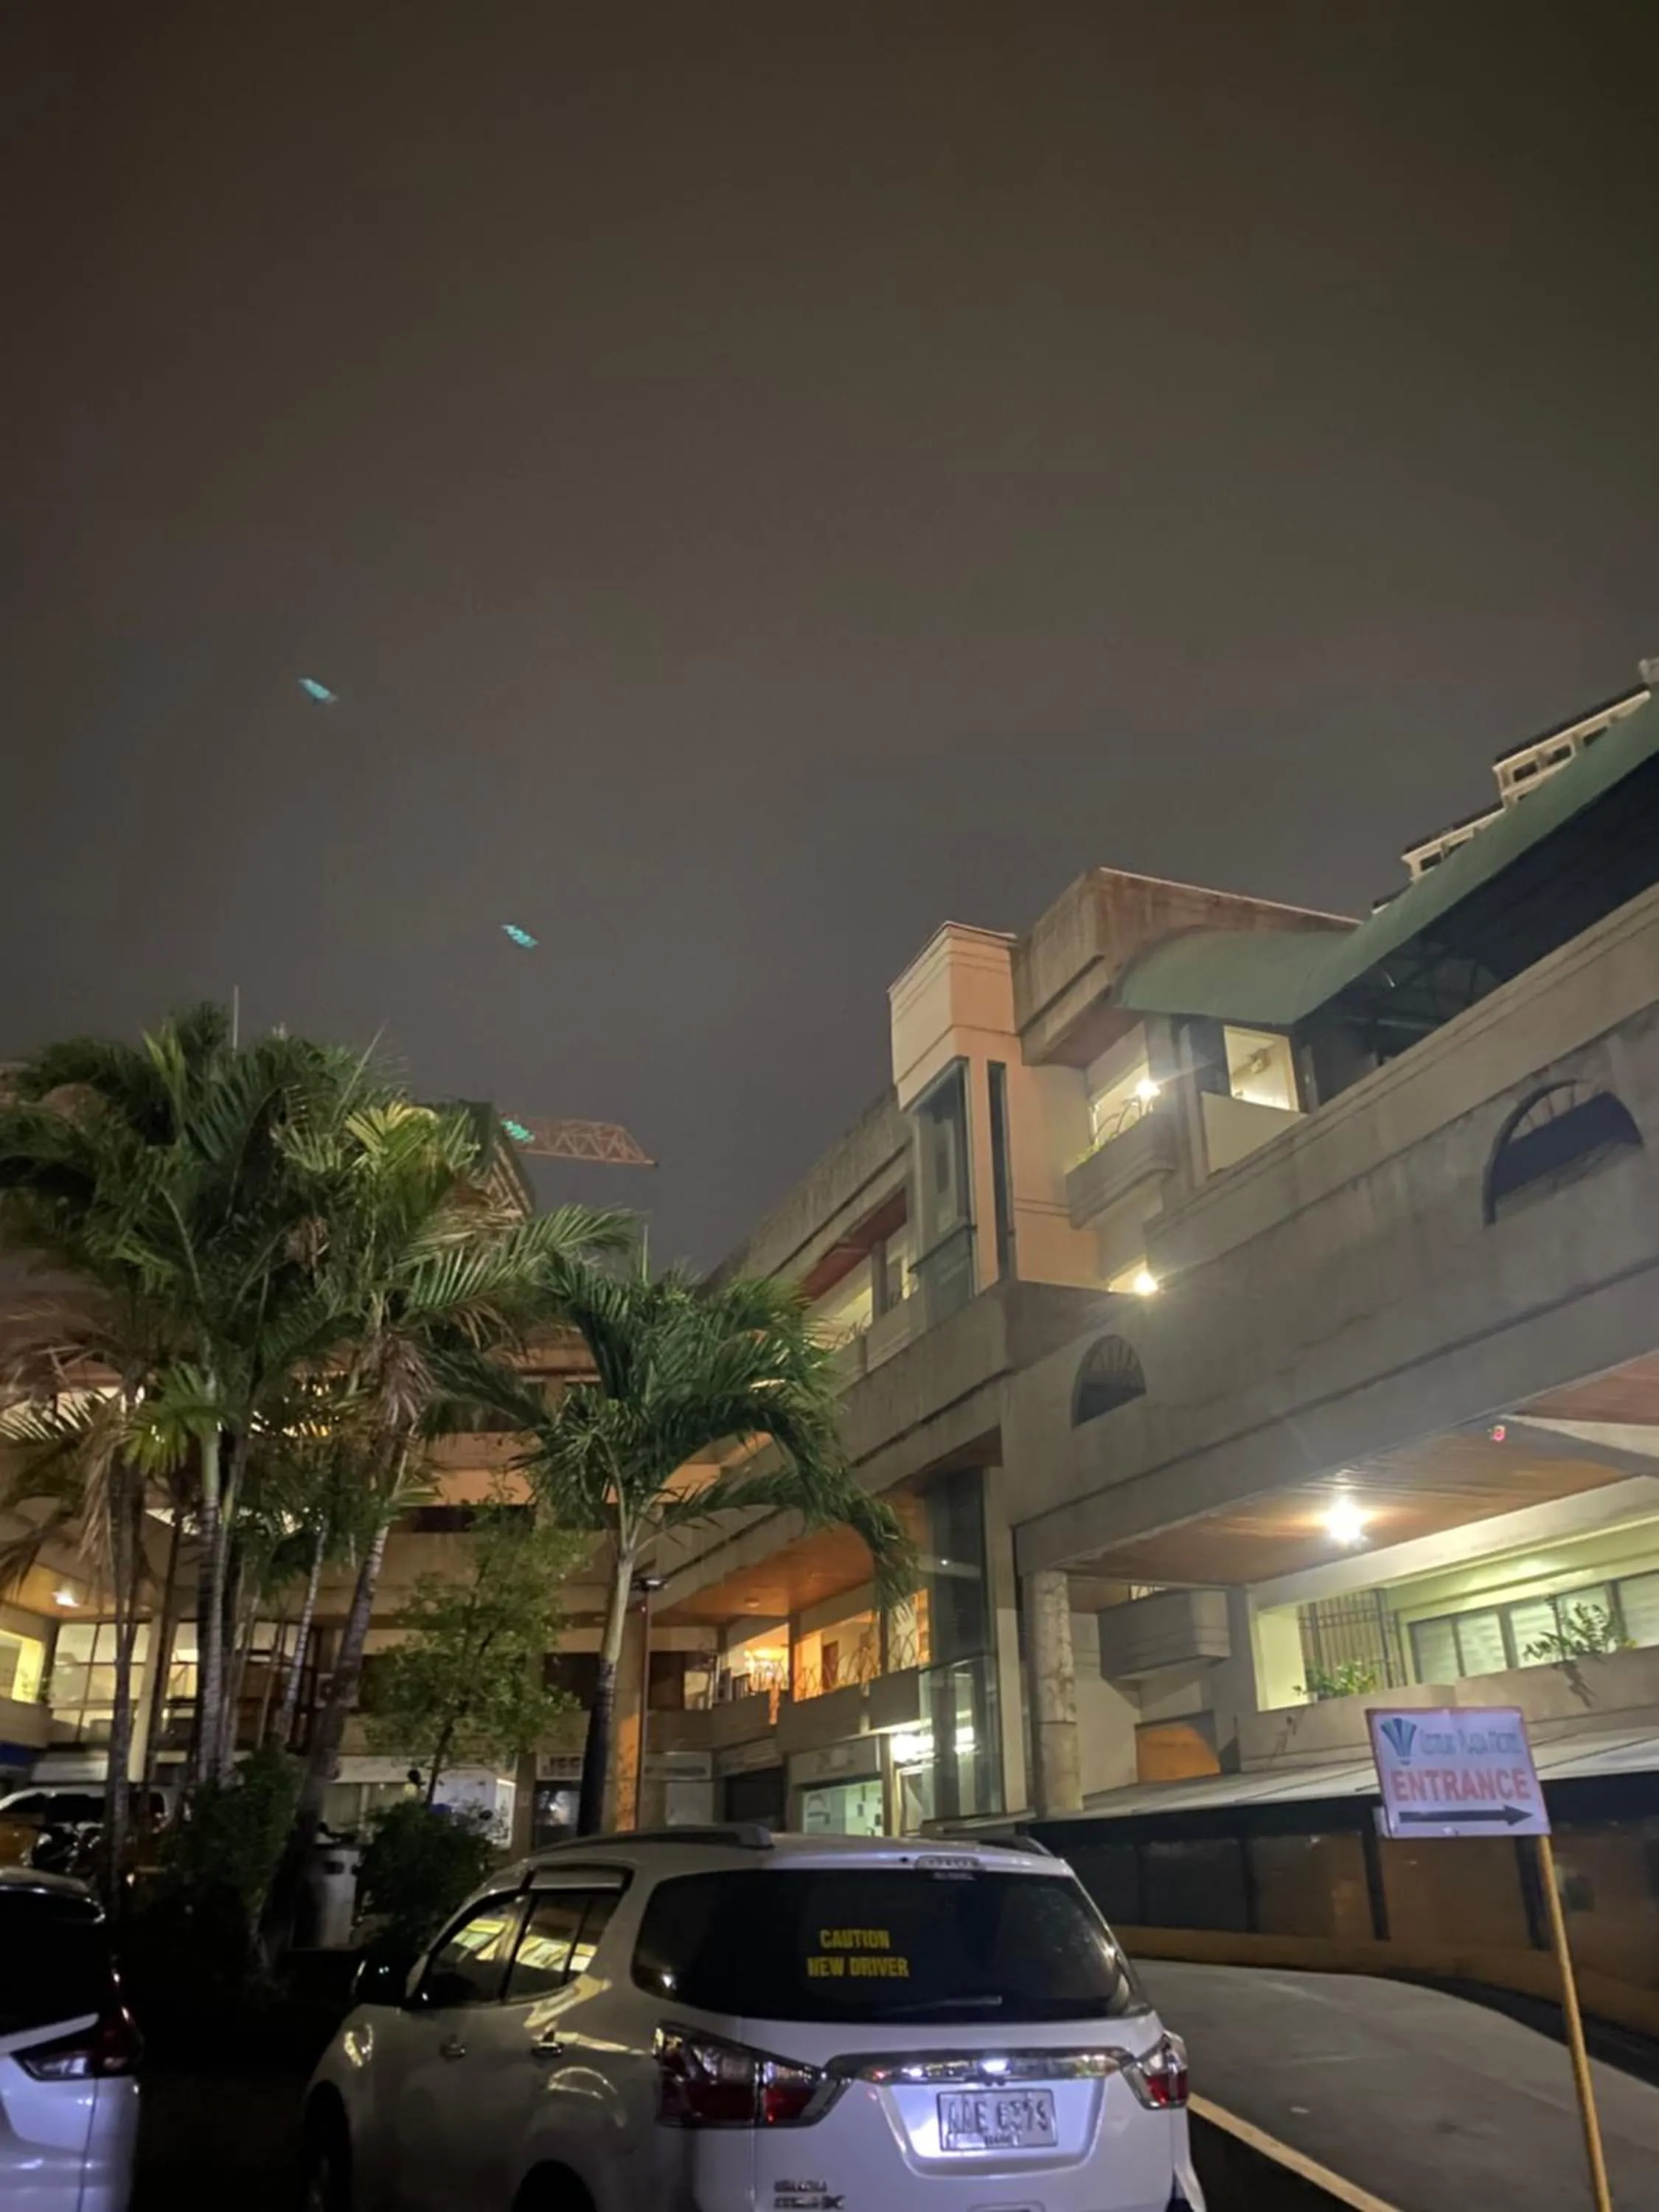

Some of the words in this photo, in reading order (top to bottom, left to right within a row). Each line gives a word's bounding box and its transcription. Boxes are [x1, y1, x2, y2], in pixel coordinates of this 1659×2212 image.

[1391, 1767, 1532, 1801] ENTRANCE
[819, 1928, 890, 1949] CAUTION
[807, 1956, 844, 1978] NEW
[849, 1956, 910, 1978] DRIVER
